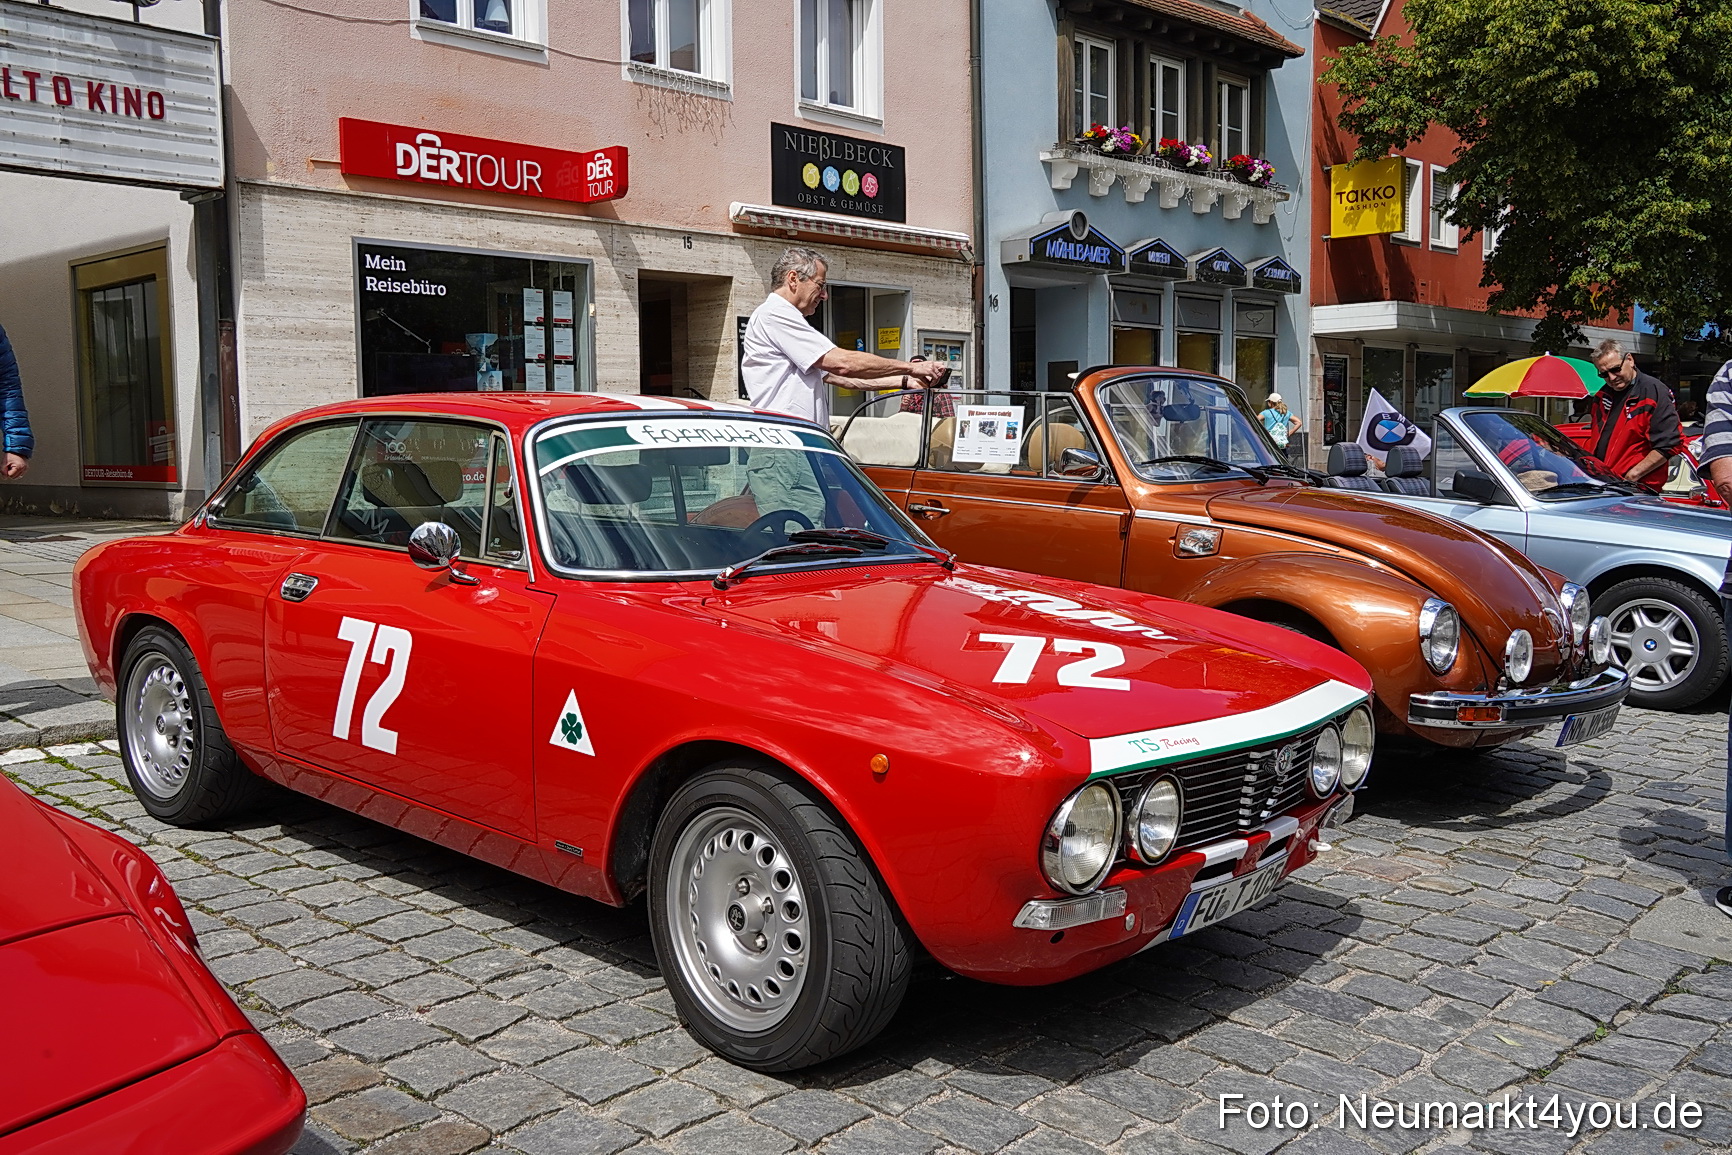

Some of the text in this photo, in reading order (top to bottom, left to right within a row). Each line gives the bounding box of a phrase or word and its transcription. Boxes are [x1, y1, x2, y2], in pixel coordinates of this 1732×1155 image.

[87, 80, 165, 120] KINO
[396, 138, 543, 193] DERTOUR
[587, 156, 614, 181] DER
[587, 180, 614, 198] TOUR
[797, 193, 884, 214] OBST & GEMÜSE
[1344, 202, 1386, 211] FASHION
[682, 235, 693, 250] 15
[365, 254, 406, 272] Mein
[366, 276, 447, 297] Reisebüro
[988, 294, 999, 308] 16
[1382, 413, 1416, 435] BMW
[978, 633, 1131, 692] 72
[332, 616, 413, 756] 72
[1128, 736, 1200, 753] TS Racing
[1188, 887, 1228, 929] FÜ
